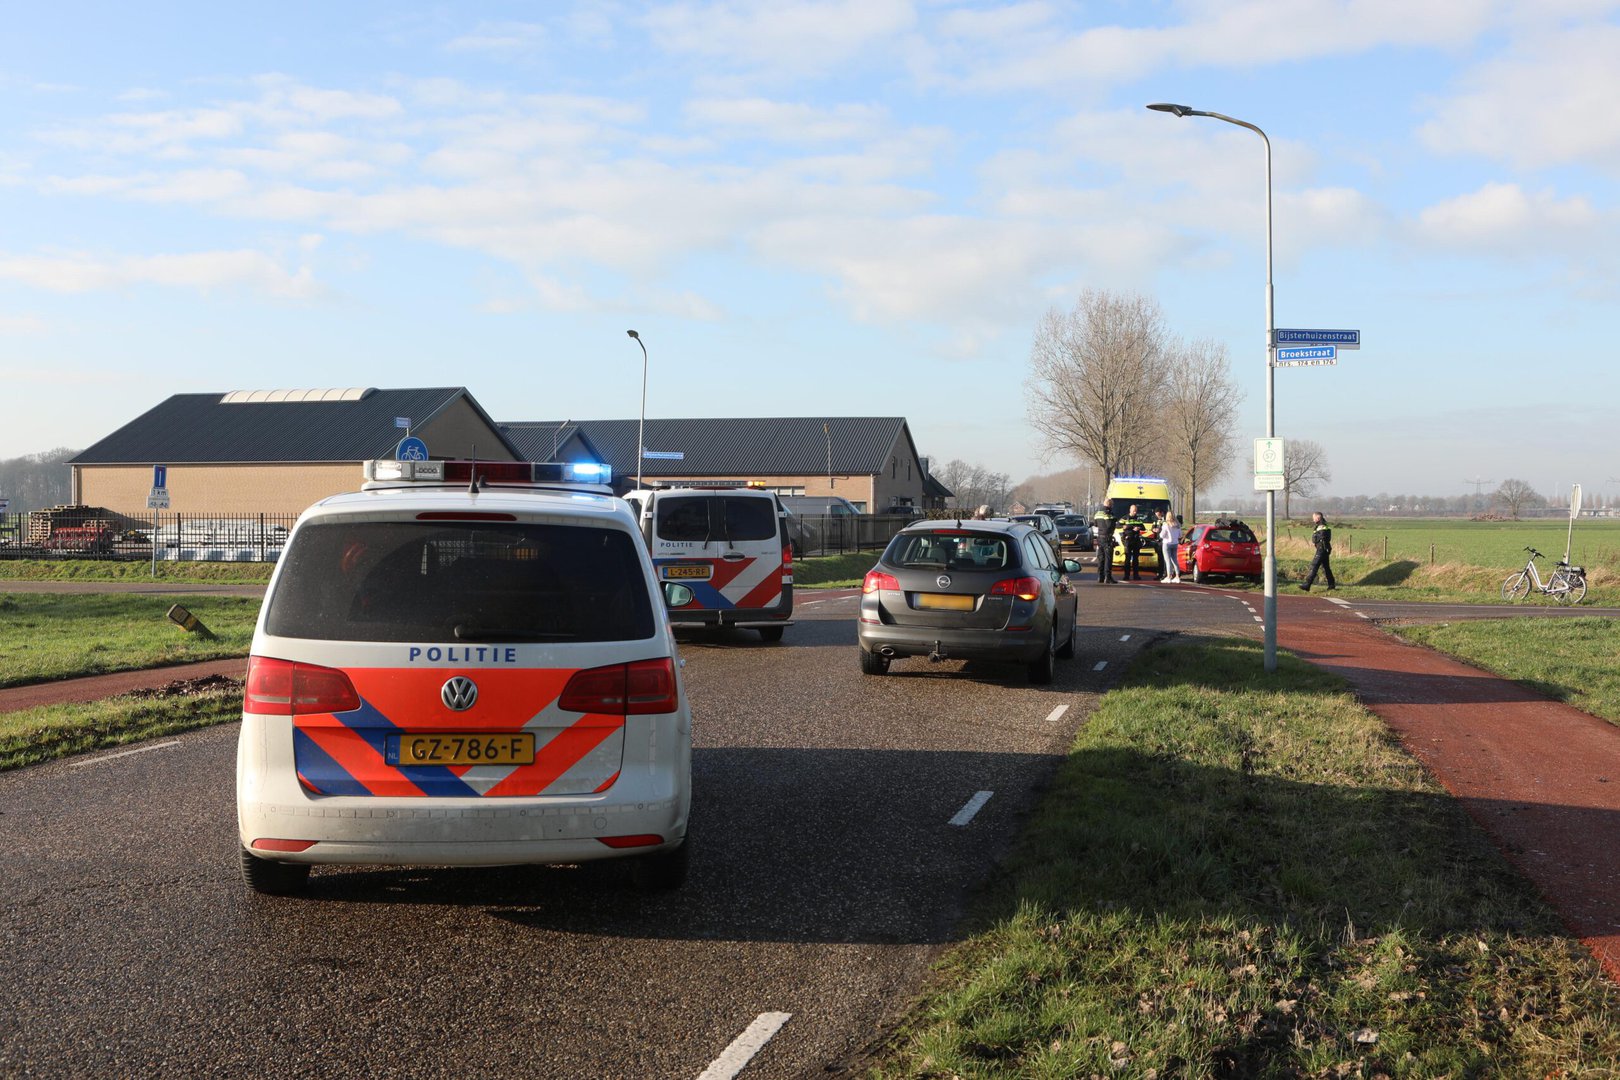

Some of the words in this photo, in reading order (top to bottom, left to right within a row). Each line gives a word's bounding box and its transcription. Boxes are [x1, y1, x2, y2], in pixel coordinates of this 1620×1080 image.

[1279, 331, 1356, 341] Bijsterhuizenstraat
[1280, 349, 1331, 358] Broekstraat
[409, 647, 516, 662] POLITIE
[410, 738, 523, 760] GZ-786-F
[387, 752, 399, 760] NL
